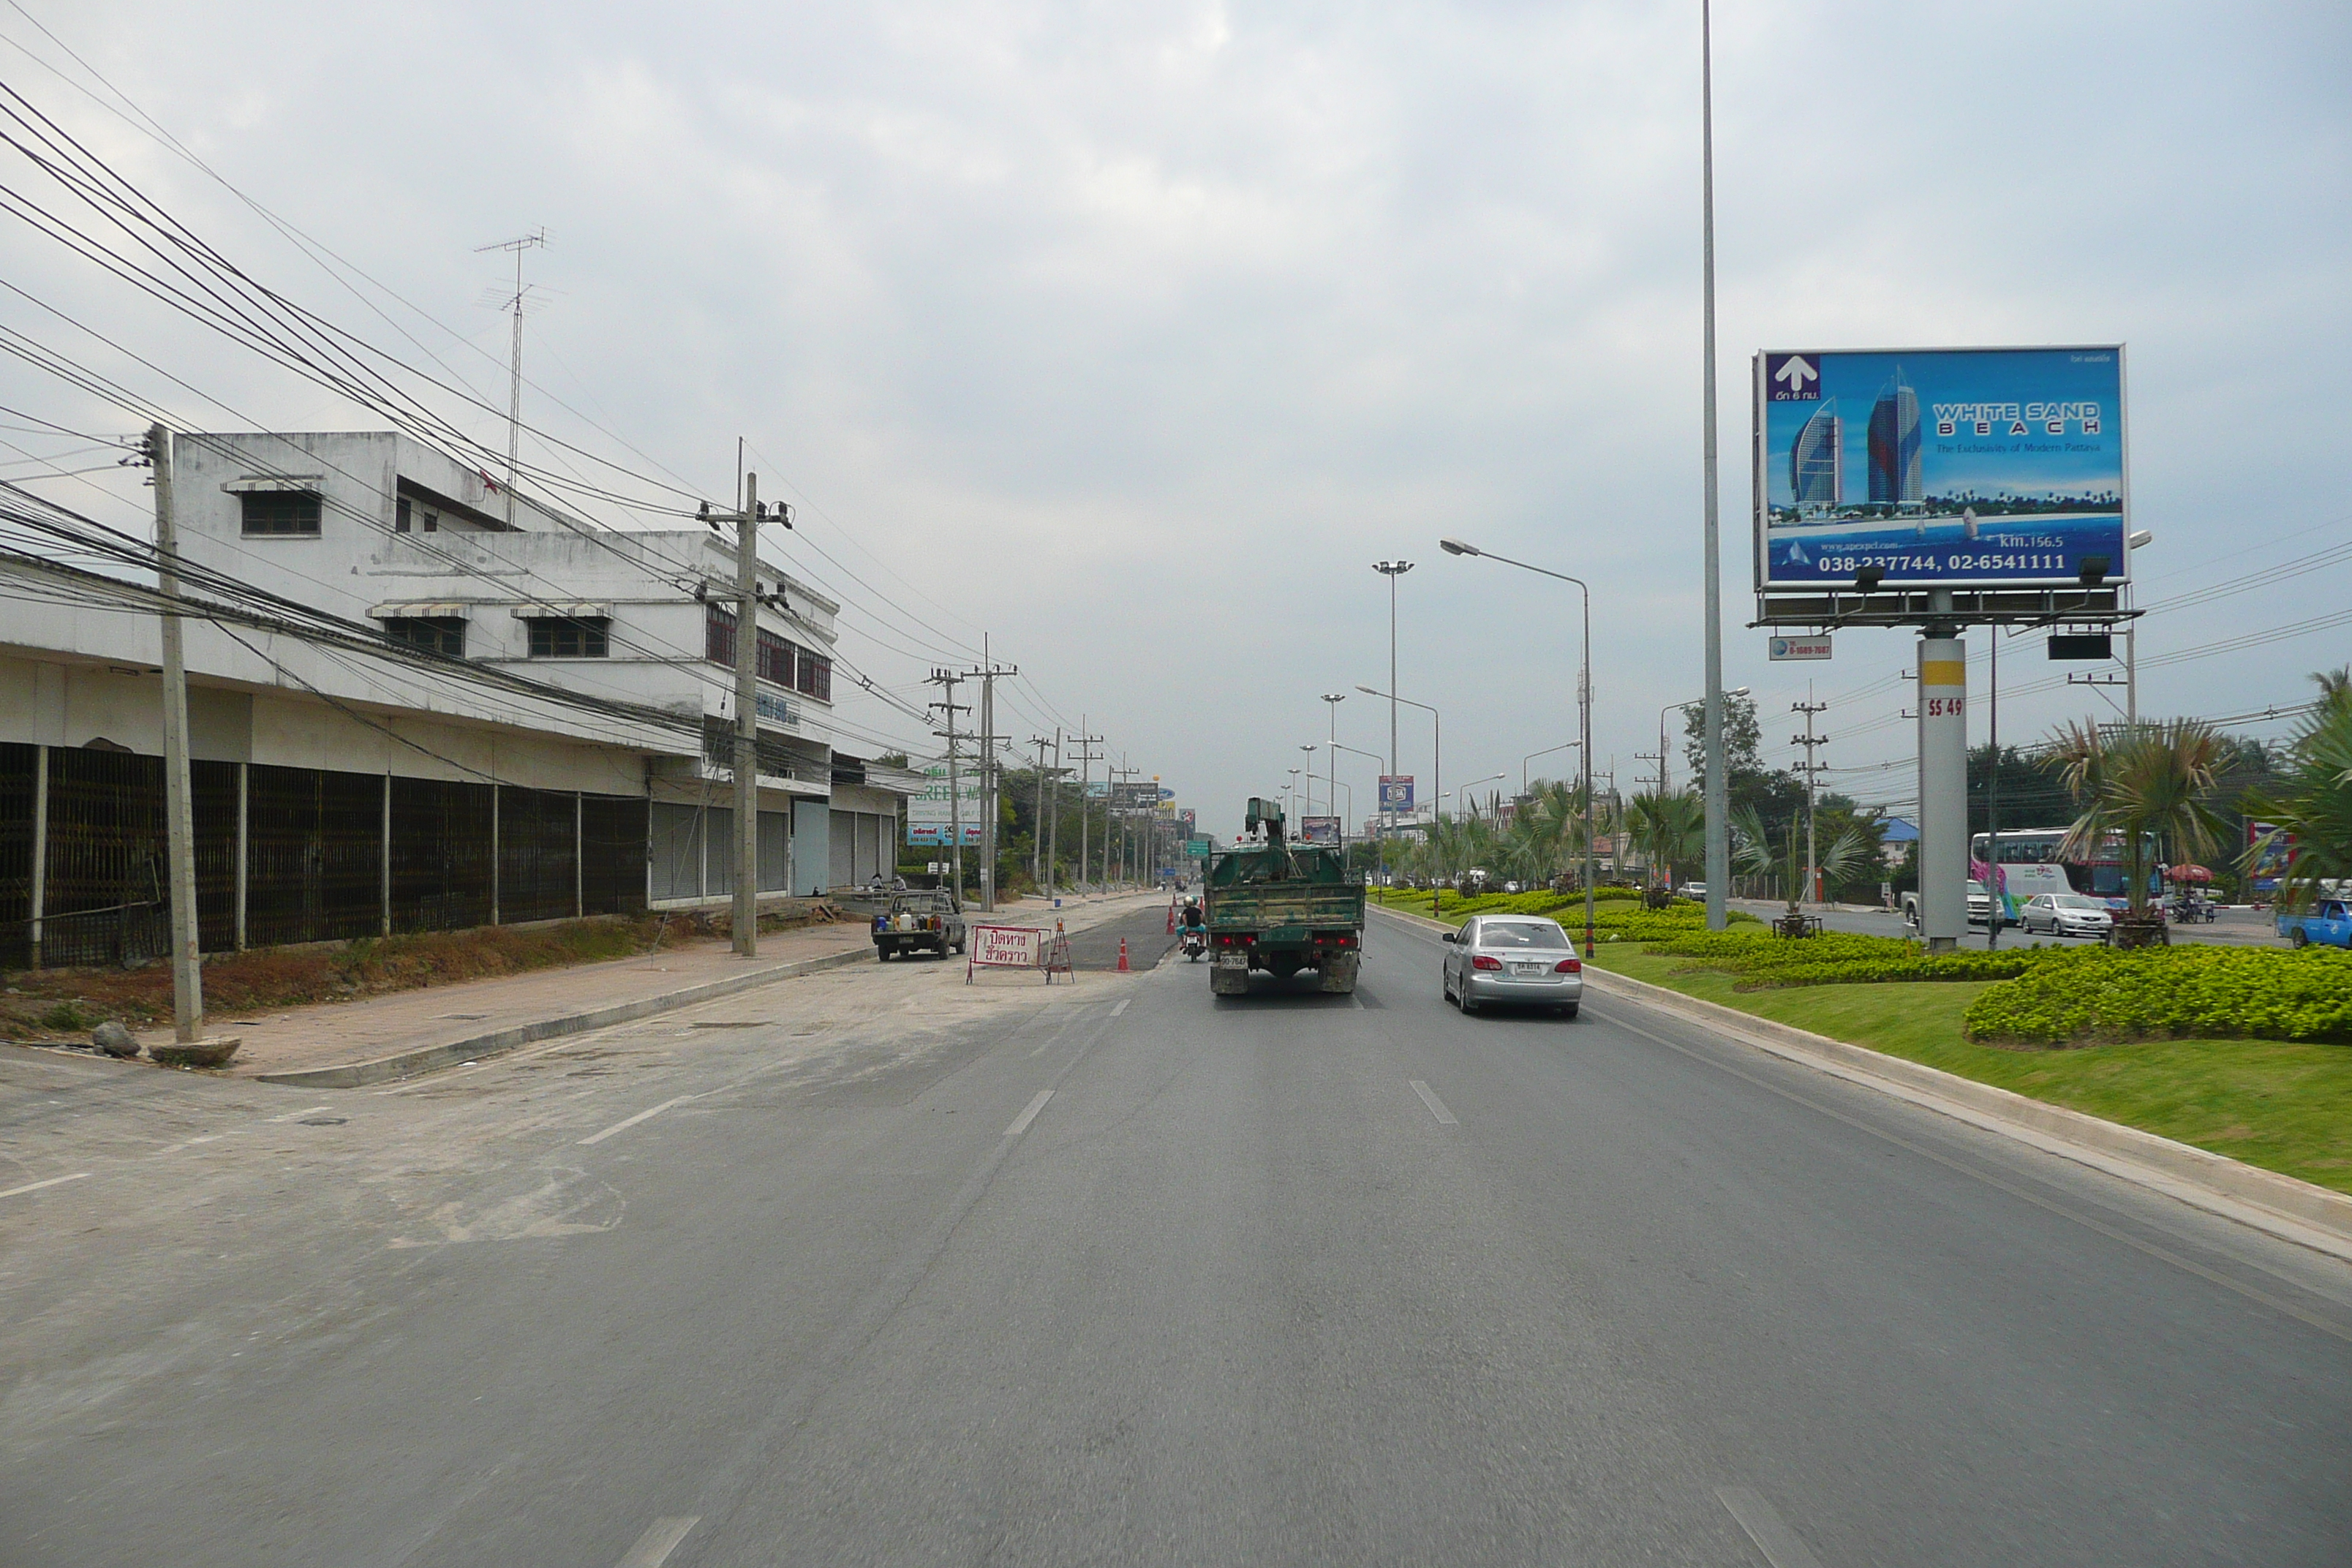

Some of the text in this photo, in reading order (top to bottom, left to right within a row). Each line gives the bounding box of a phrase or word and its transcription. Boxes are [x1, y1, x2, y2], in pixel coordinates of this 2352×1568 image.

[1793, 391, 1800, 400] 6
[1933, 402, 2101, 421] WHITE SAND
[1938, 420, 2100, 435] BEACH
[1937, 443, 2100, 453] The Exclusivity of Modern Pattaya
[1948, 554, 2065, 570] 02-6541111
[1929, 698, 1962, 716] SS 49
[990, 929, 1026, 946] ปิดทาง
